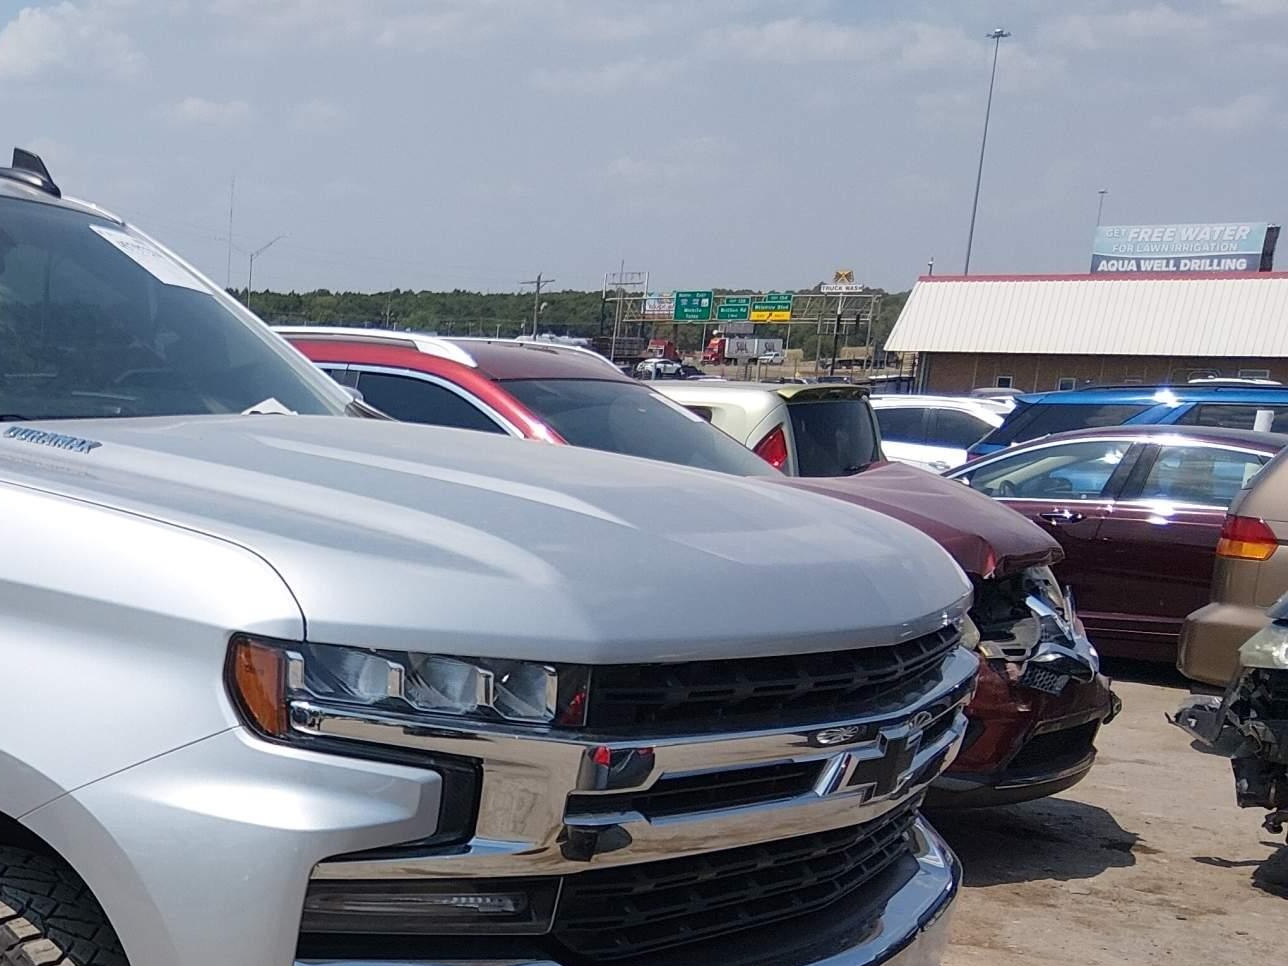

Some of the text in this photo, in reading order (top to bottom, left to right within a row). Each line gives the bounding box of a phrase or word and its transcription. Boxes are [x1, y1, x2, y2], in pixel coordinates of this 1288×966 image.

[1105, 225, 1251, 242] GET FREE WATER
[1112, 242, 1238, 253] FOR LAWN IRRIGATION
[1097, 258, 1247, 272] AQUA WELL DRILLING
[3, 425, 102, 455] DURAMAX
